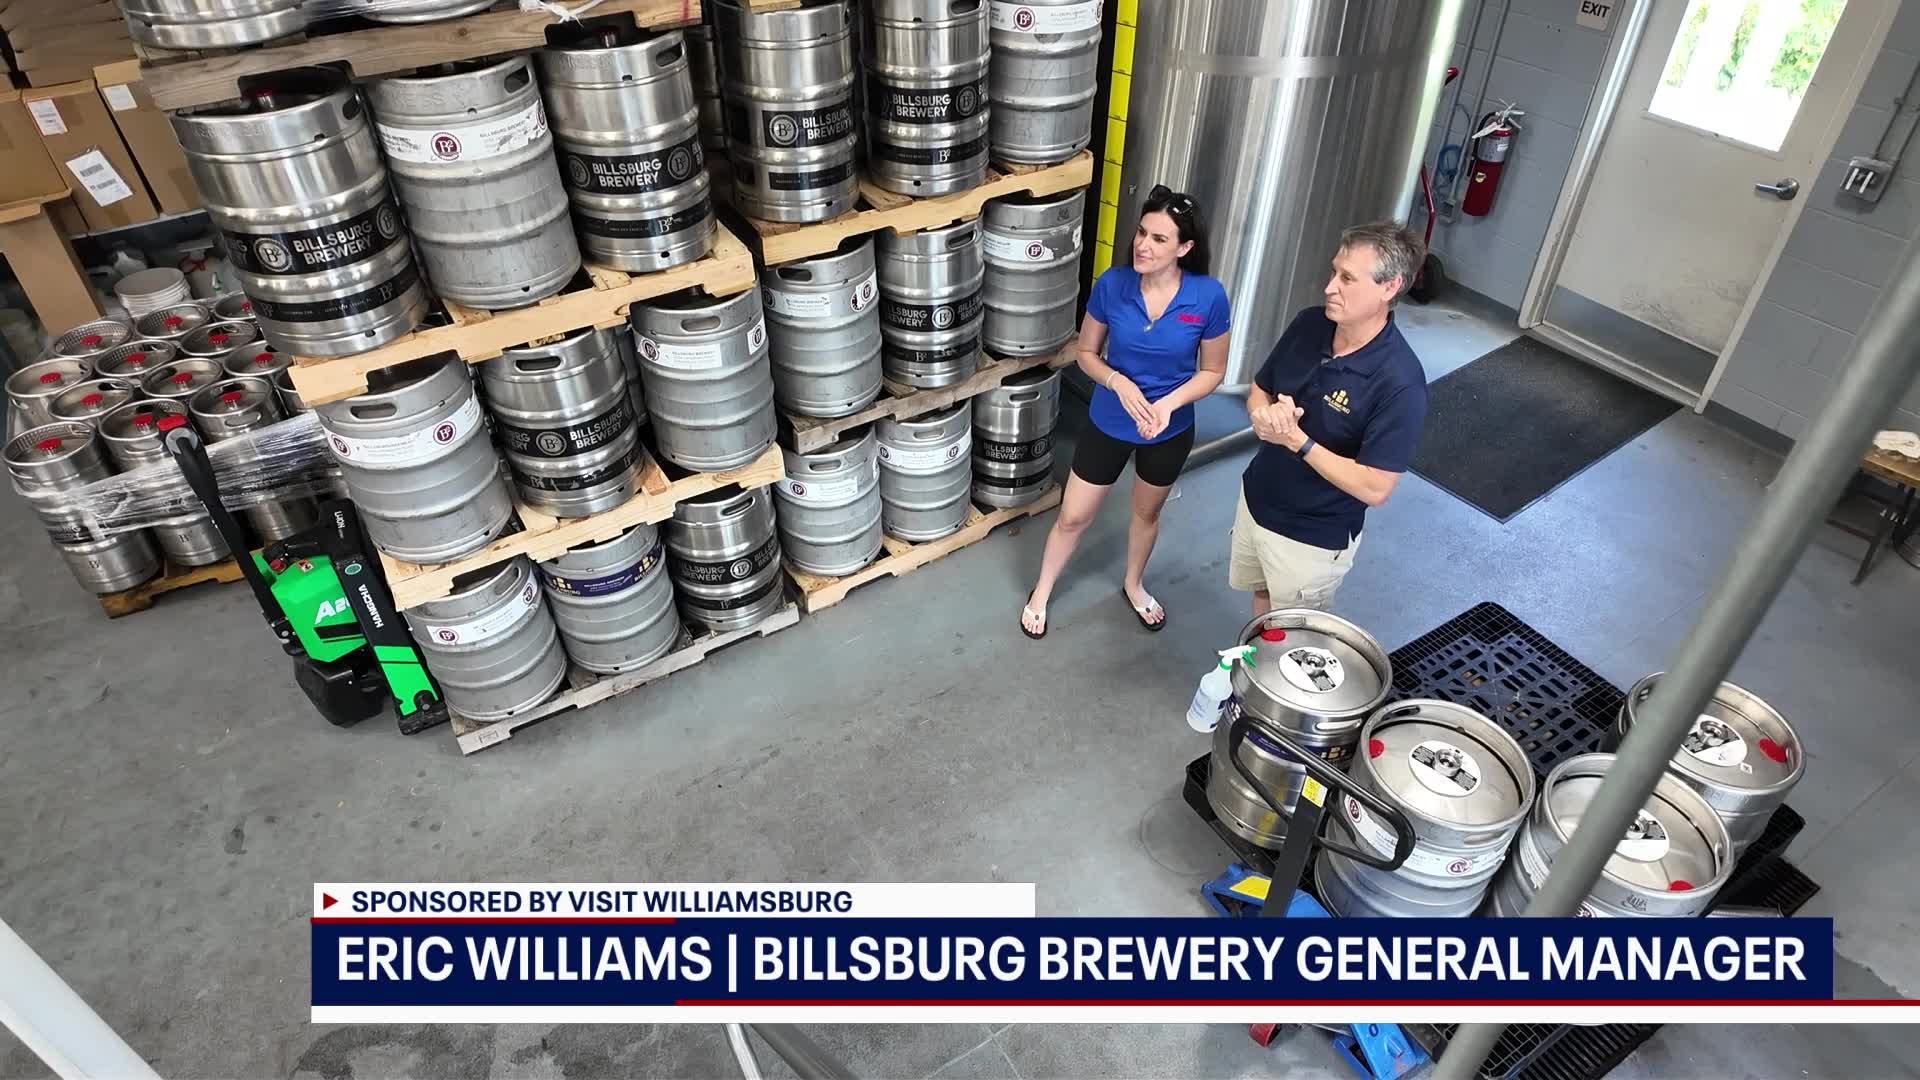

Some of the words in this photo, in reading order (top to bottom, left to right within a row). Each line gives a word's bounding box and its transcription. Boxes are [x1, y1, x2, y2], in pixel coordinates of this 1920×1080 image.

[1581, 1, 1610, 18] EXIT
[892, 94, 952, 107] BILLSBURG
[896, 106, 948, 118] BREWERY
[807, 119, 850, 140] BREWERY
[592, 158, 663, 176] BILLSBURG
[599, 172, 660, 188] BREWERY
[293, 220, 373, 253] BILLSBURG
[303, 236, 373, 266] BREWERY
[570, 408, 623, 441] BILLSBURG
[575, 421, 622, 449] BREWERY
[358, 583, 385, 629] HANGCHA
